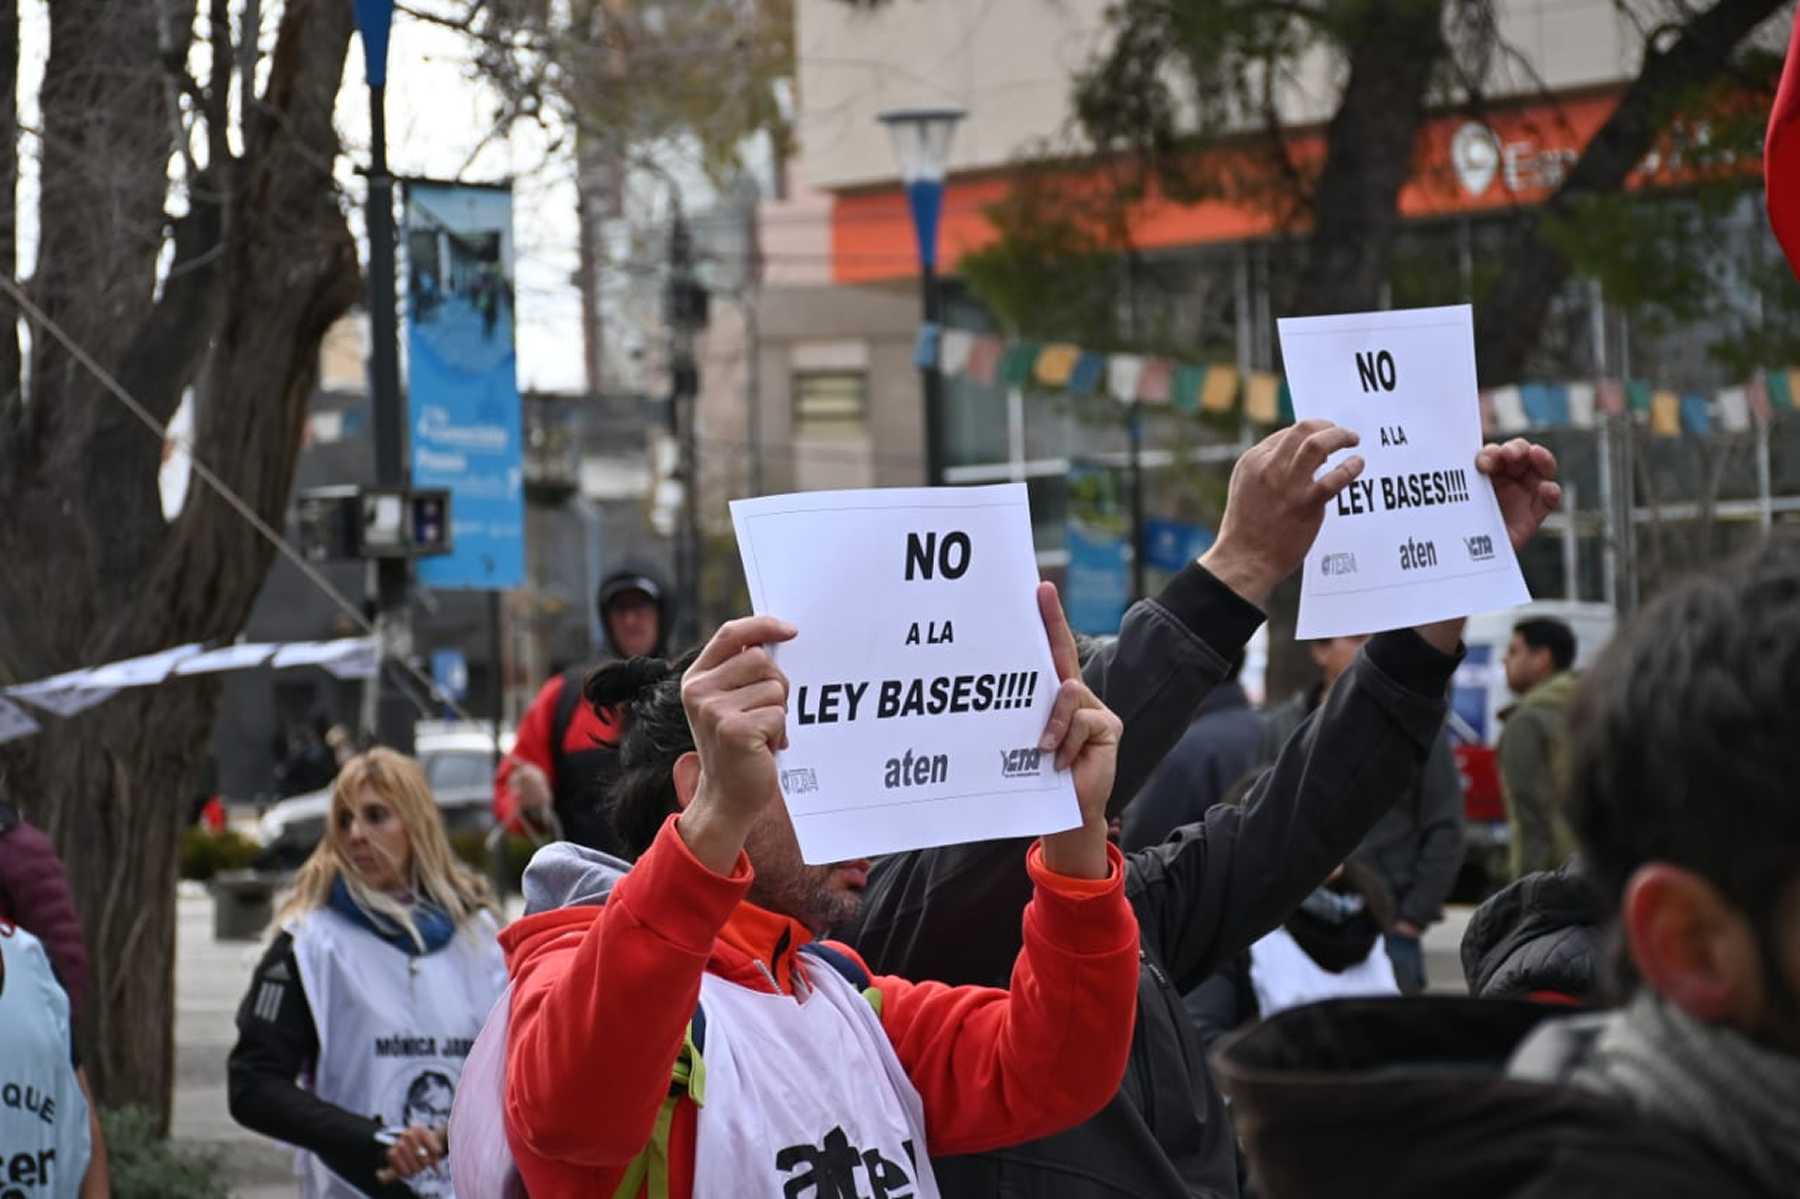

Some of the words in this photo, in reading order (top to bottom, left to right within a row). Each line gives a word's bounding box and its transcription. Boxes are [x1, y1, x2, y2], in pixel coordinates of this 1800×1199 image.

[1355, 350, 1396, 393] NO
[1380, 427, 1391, 447] A
[1390, 425, 1408, 446] LA
[1337, 478, 1374, 517] LEY
[1380, 469, 1469, 512] BASES!!!!
[904, 531, 972, 581] NO
[1399, 537, 1438, 571] aten
[905, 622, 921, 646] A
[927, 620, 954, 645] LA
[797, 677, 869, 726] LEY
[876, 671, 1039, 719] BASES!!!!
[884, 749, 948, 789] aten
[376, 1034, 437, 1058] MÓNICA
[2, 1082, 57, 1125] QUE
[0, 1147, 57, 1187] er
[775, 1125, 920, 1199] ate
